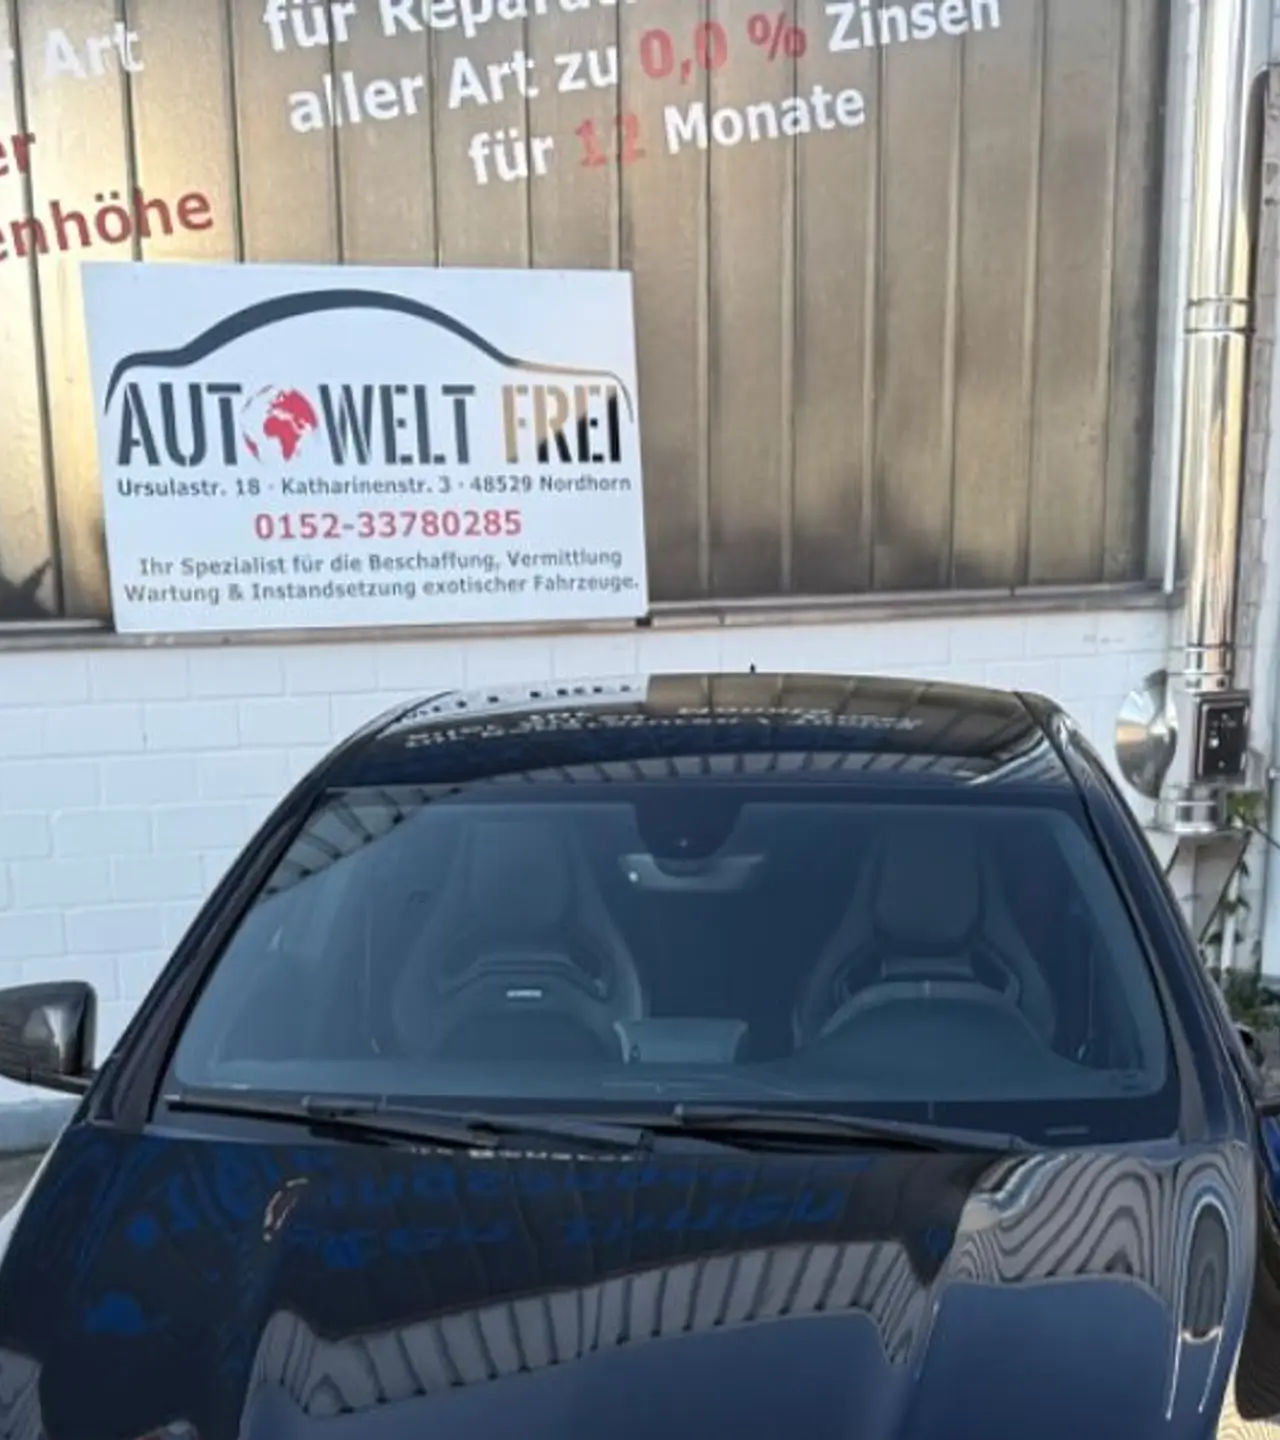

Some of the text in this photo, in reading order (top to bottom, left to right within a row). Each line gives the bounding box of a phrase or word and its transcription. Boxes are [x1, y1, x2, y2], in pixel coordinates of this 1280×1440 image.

[43, 22, 144, 79] Art
[263, 0, 357, 51] für
[287, 0, 1001, 134] aller Art zu 0,0 % Zinsen
[469, 128, 554, 185] für
[664, 84, 865, 155] Monate
[502, 384, 622, 463] FREI
[117, 475, 632, 497] Ursulastr. 18 Katharinenstr. 3 48529 Nordhorn
[255, 510, 522, 541] 0152-33780285
[139, 557, 173, 576] Ihr
[180, 556, 286, 578] Spezialist
[292, 555, 324, 574] für
[330, 553, 362, 571] die
[506, 549, 622, 569] Vermittlung
[124, 583, 219, 605] Wartung
[228, 584, 244, 600] &
[251, 579, 416, 601] Instandsetzung
[422, 575, 526, 596] exotischer
